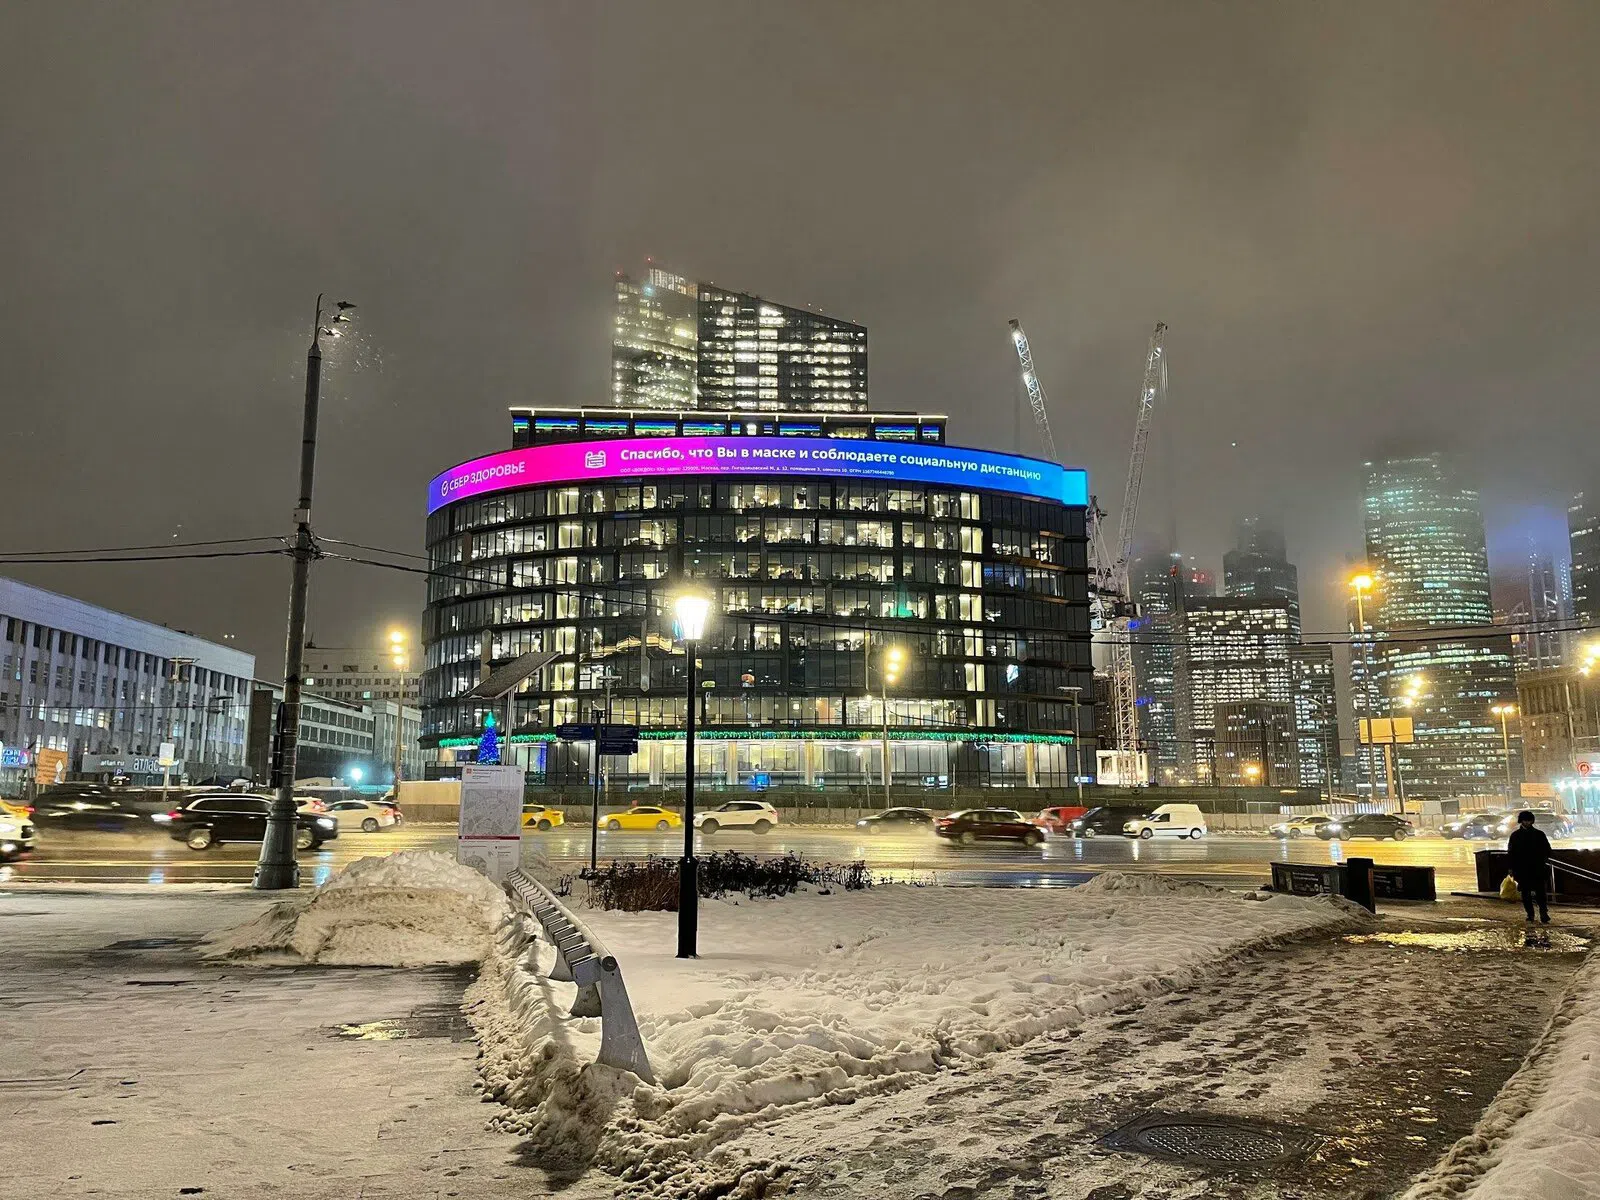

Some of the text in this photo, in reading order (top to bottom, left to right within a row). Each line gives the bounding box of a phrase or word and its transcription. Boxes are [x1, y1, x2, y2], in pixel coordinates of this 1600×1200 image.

[470, 461, 526, 485] ЗДОРОВЬЕ
[620, 447, 1041, 481] Спасибо, что Вы в маске и соблюдаете социальную дистанцию
